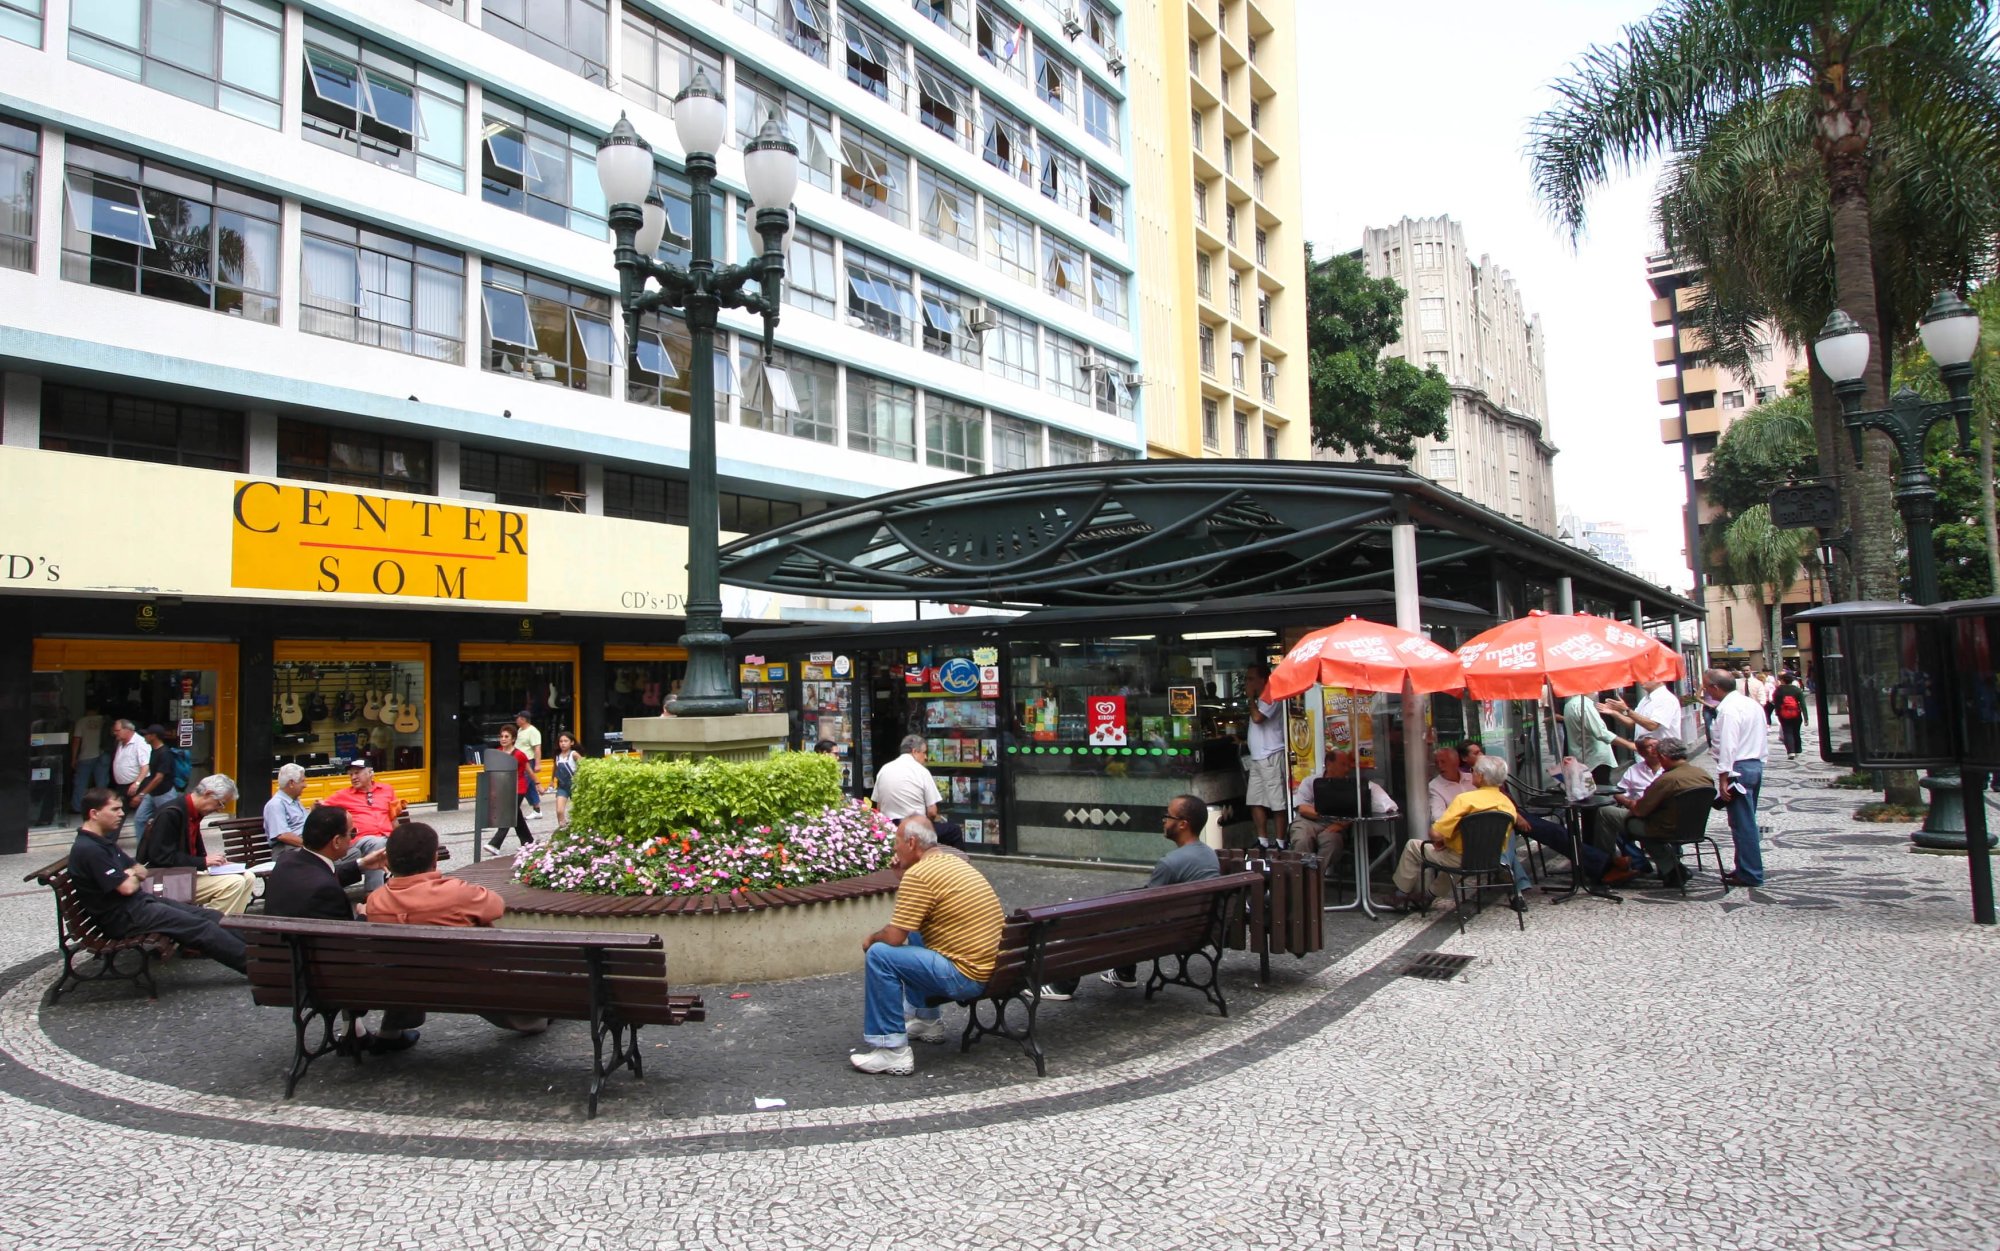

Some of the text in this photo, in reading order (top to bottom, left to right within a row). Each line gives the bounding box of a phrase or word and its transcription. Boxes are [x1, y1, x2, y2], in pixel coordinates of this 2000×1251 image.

[233, 481, 527, 555] CENTER
[0, 554, 60, 582] D's
[318, 556, 468, 600] SOM
[1333, 636, 1384, 650] matte
[1485, 641, 1536, 661] matte
[1546, 633, 1593, 656] matte
[1498, 652, 1536, 668] leão
